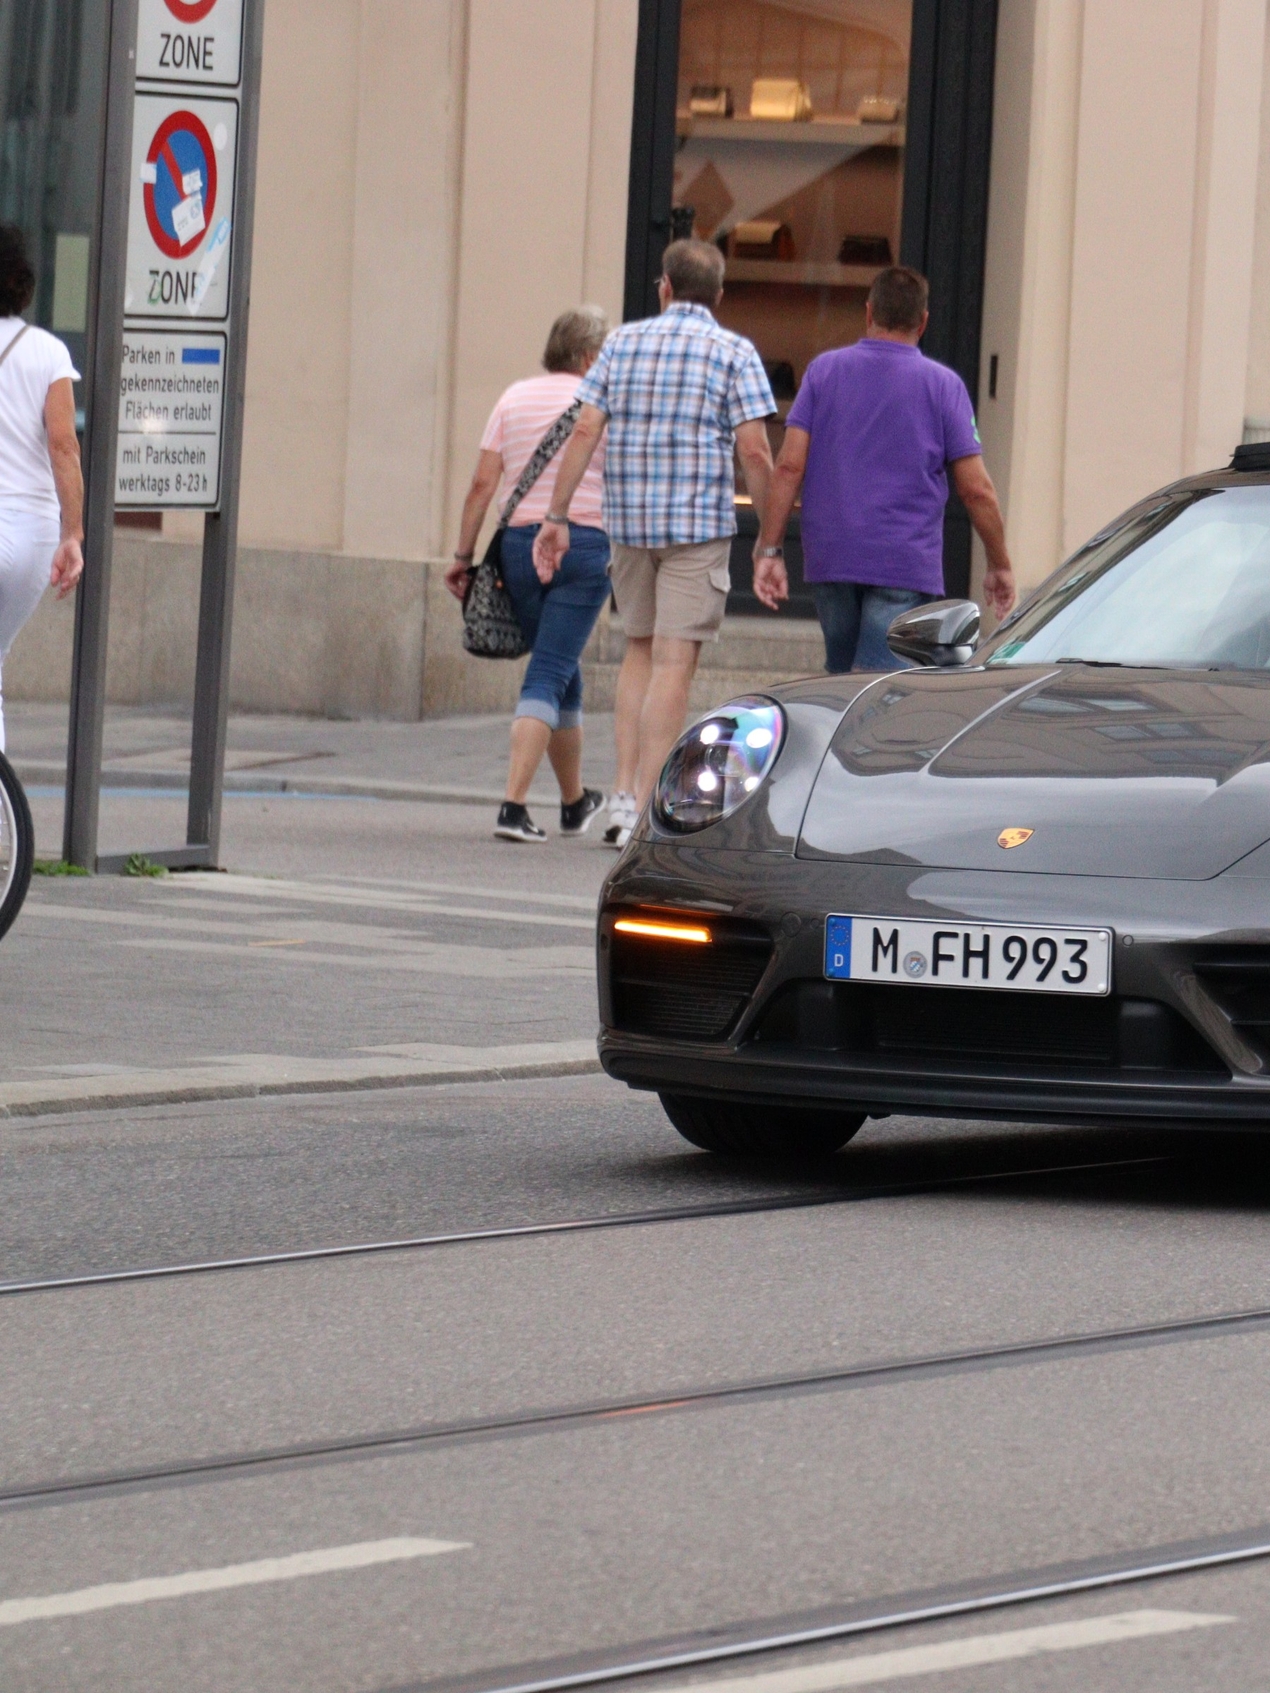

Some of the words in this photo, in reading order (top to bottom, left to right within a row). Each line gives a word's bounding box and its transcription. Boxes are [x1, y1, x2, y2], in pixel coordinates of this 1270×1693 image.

[159, 32, 214, 71] ZONE
[121, 344, 161, 364] Parken
[165, 346, 175, 364] in
[120, 373, 219, 396] gekennzeichneten
[125, 401, 168, 420] Flächen
[173, 402, 211, 421] erlaubt
[122, 445, 141, 465] mit
[145, 445, 206, 465] Parkschein
[119, 473, 170, 497] werktags
[834, 953, 844, 967] D
[872, 926, 899, 974] M
